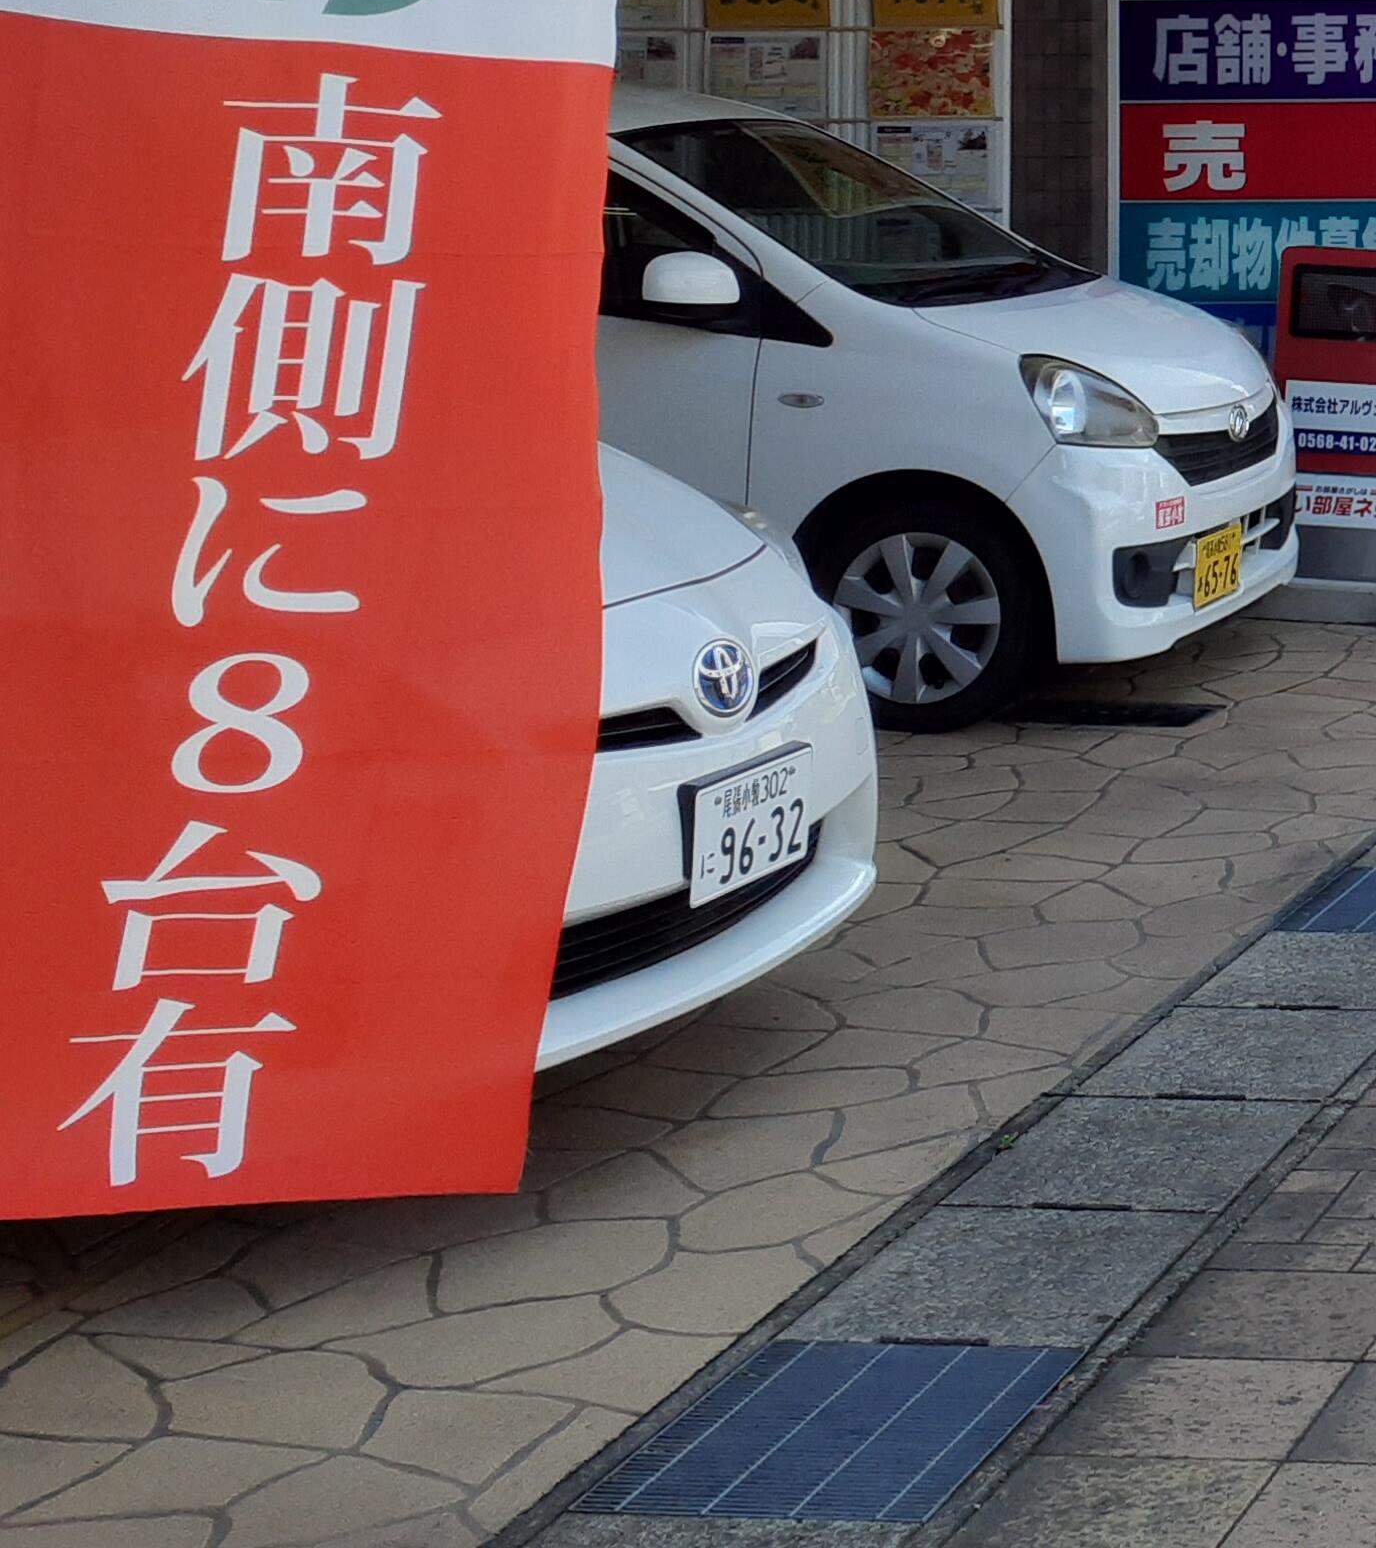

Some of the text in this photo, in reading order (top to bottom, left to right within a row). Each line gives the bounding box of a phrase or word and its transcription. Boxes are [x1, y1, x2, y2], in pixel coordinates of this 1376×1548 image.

[57, 73, 443, 1186] 南側に8台有
[718, 798, 804, 885] 96-32
